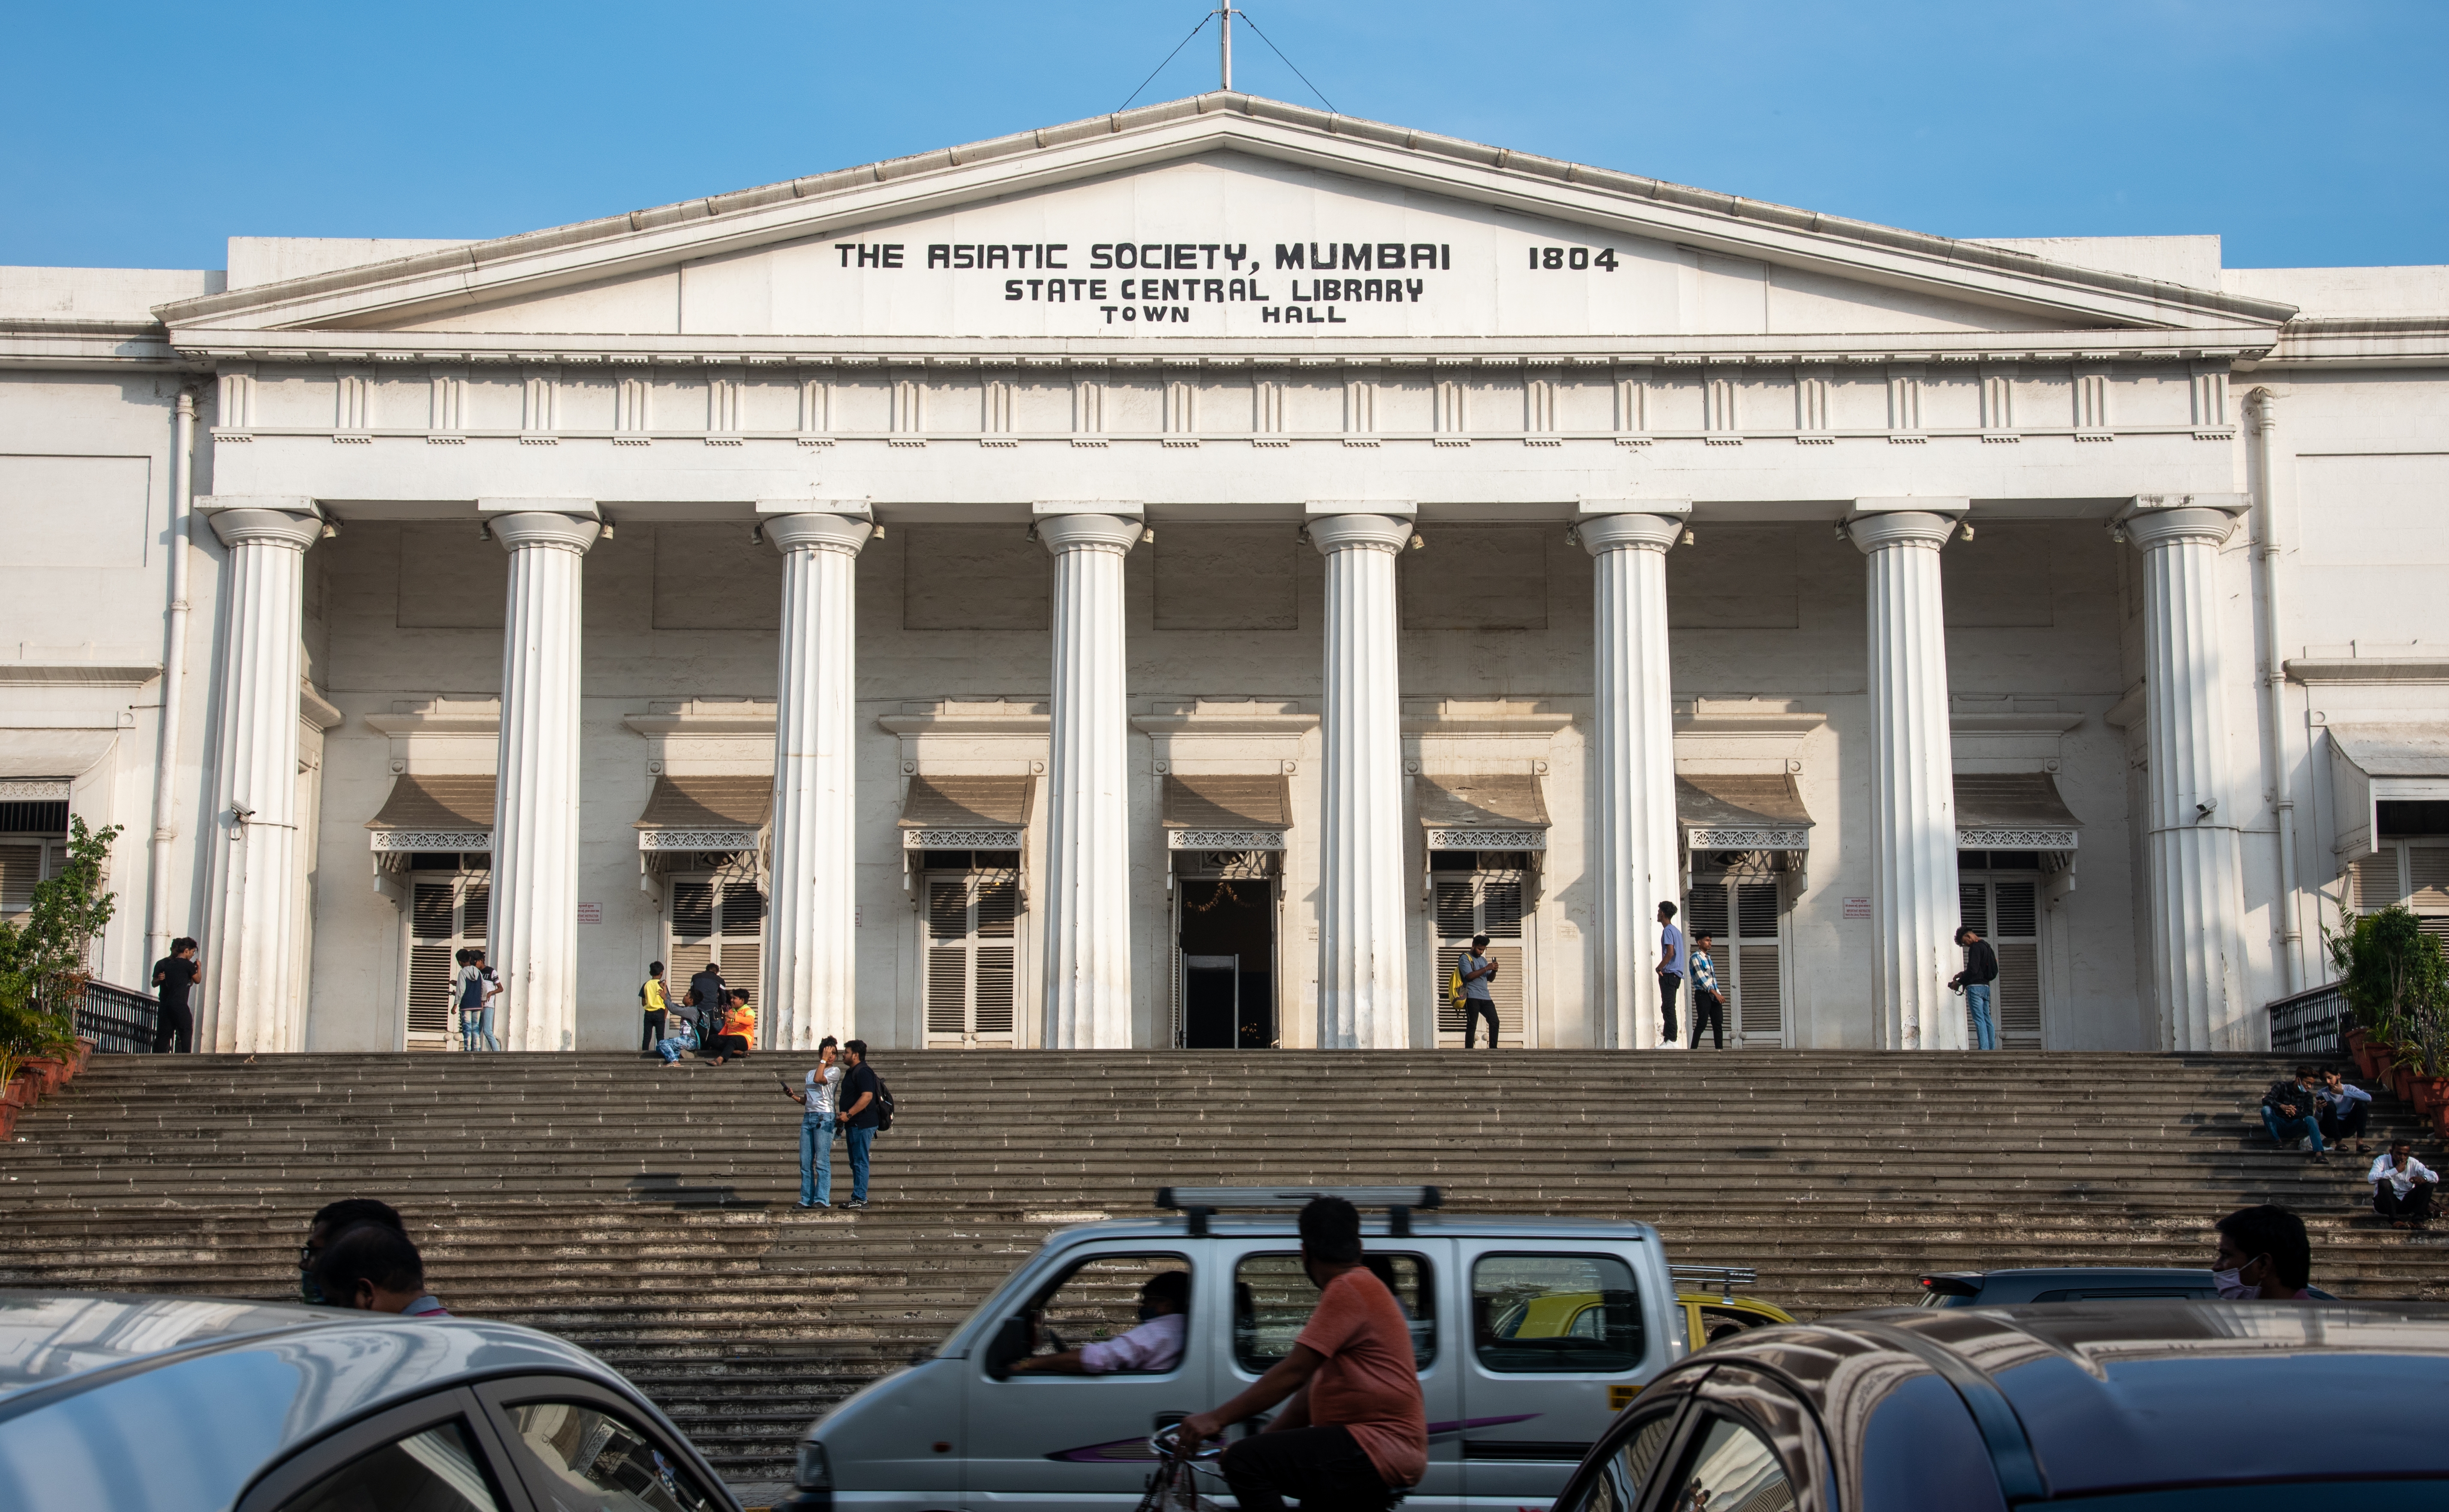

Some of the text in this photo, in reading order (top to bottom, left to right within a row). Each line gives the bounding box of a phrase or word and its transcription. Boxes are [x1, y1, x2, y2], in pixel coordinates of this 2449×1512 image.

[835, 243, 1619, 276] THE ASIATIC SOCIETY, MUMBAI 1804
[1005, 278, 1423, 303] STATE CENTRAL LIBRARY
[1100, 306, 1346, 324] TOWN HALL
